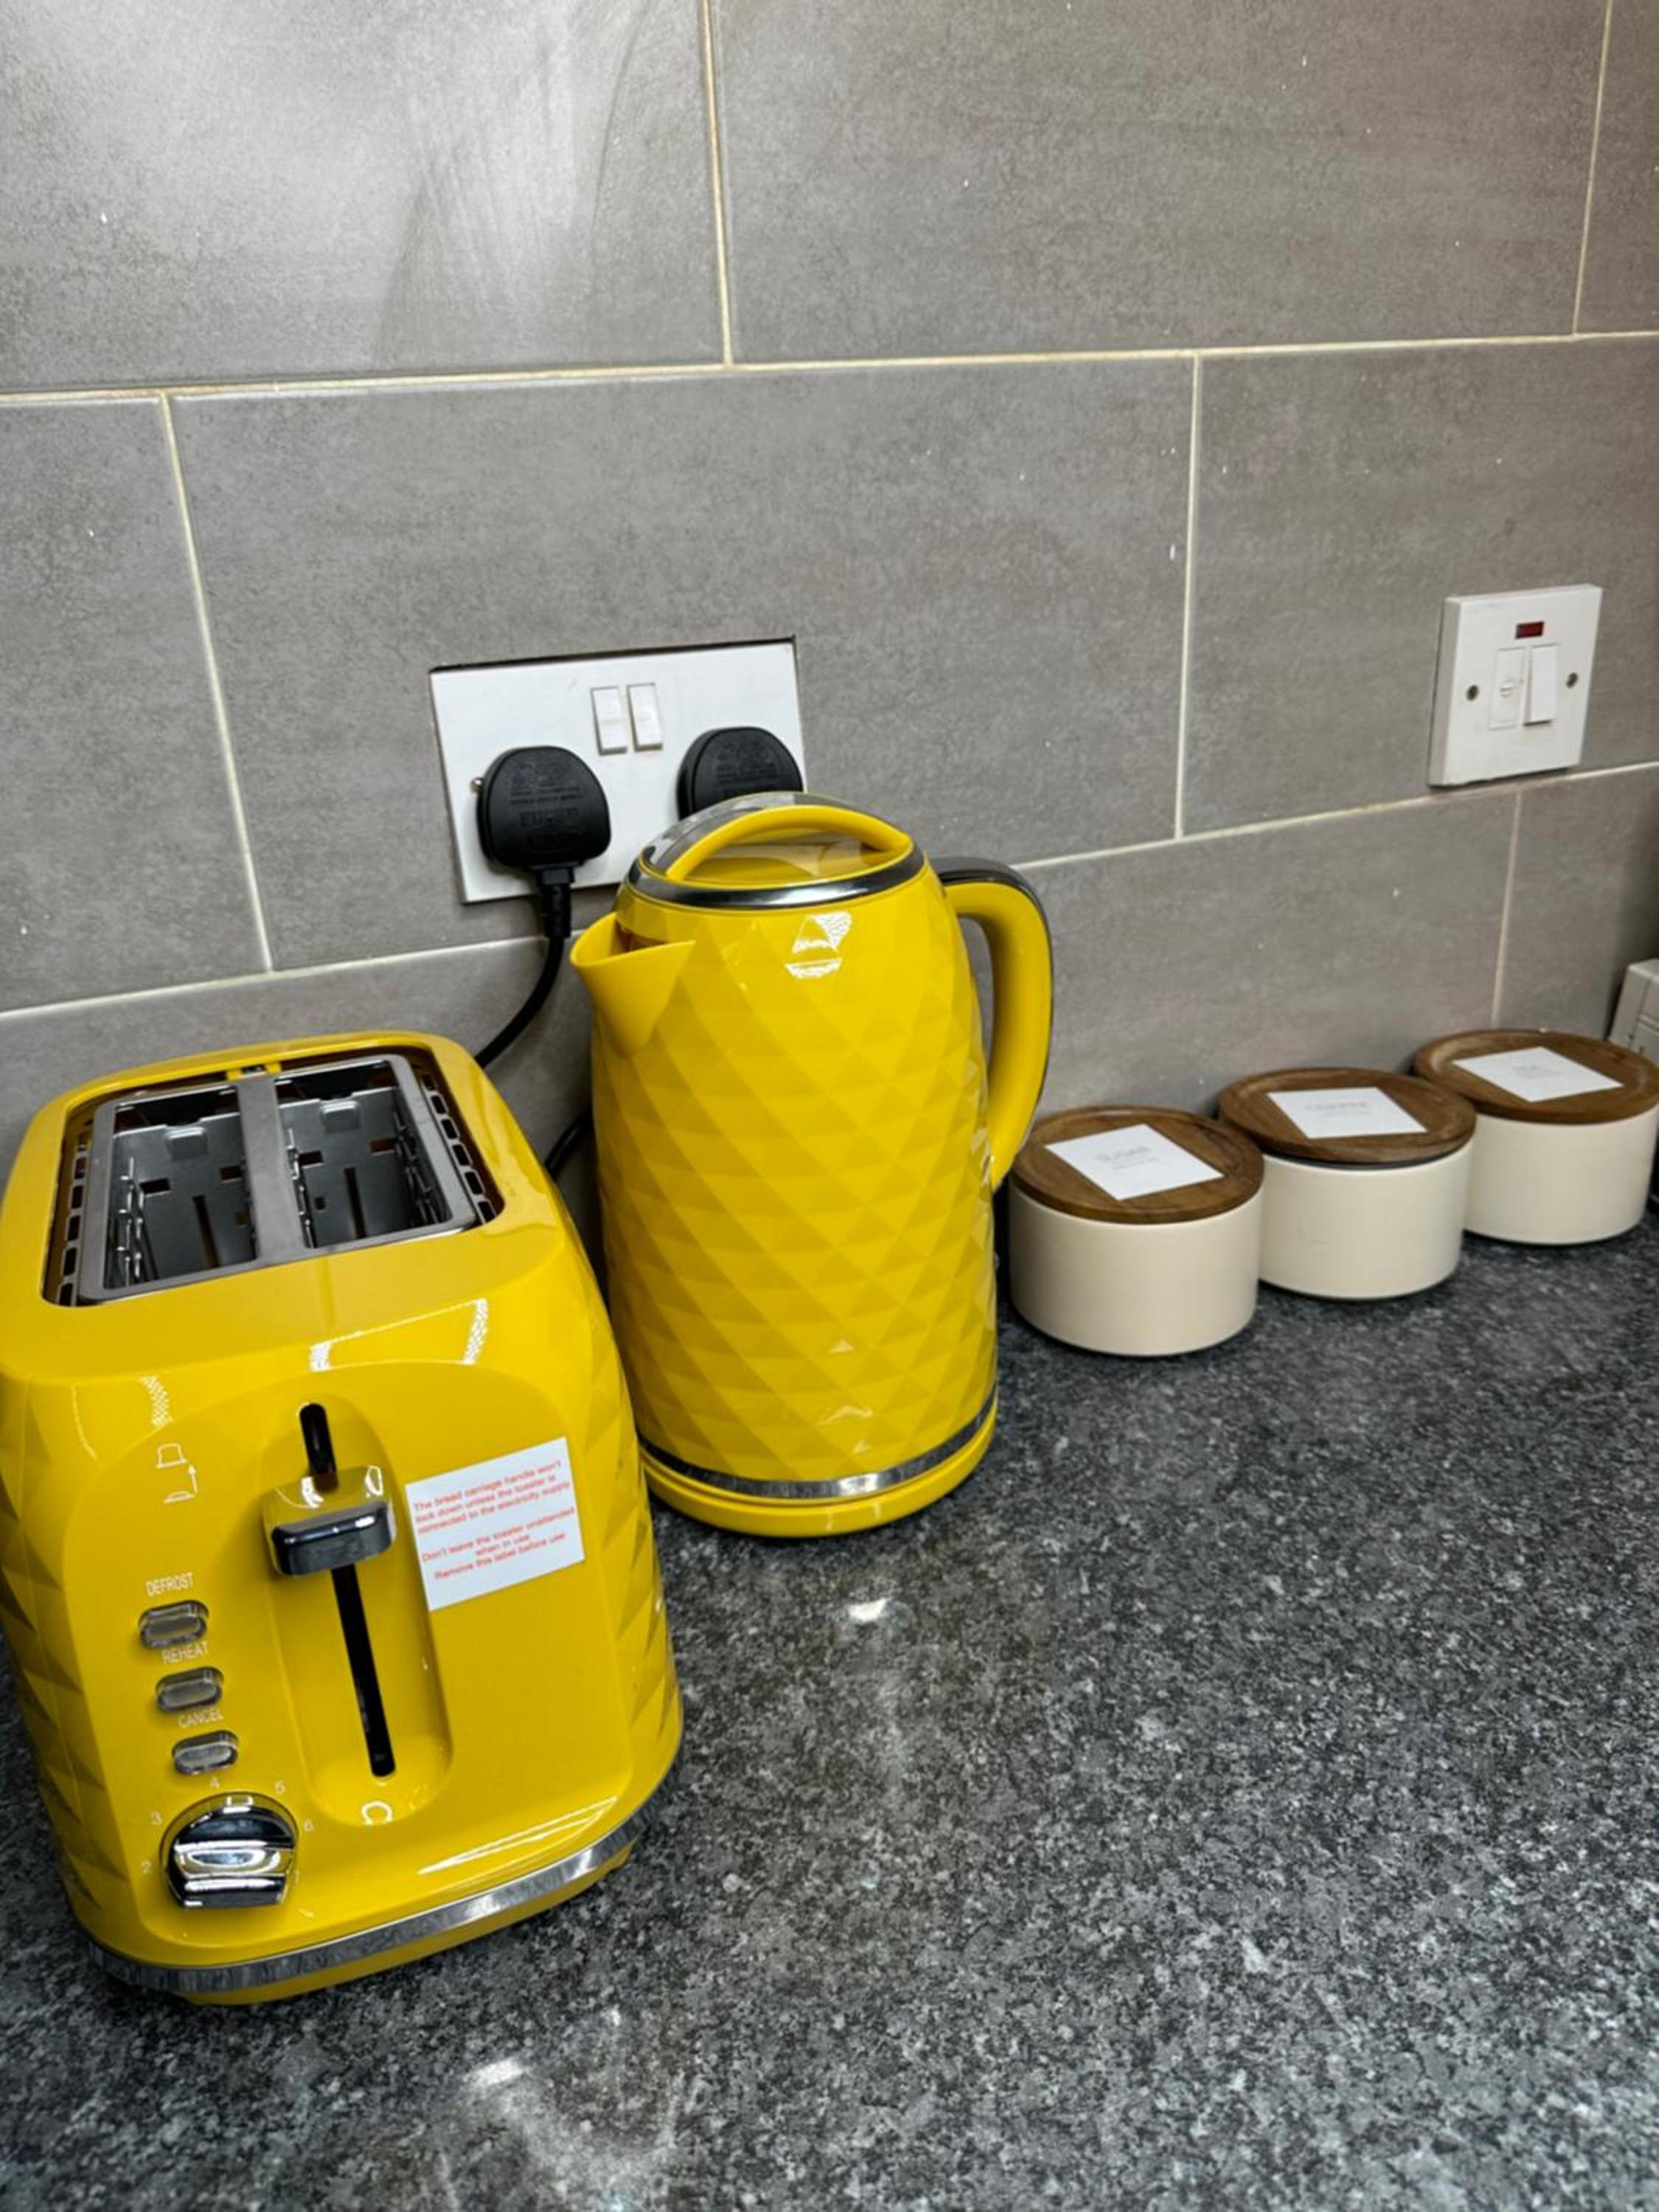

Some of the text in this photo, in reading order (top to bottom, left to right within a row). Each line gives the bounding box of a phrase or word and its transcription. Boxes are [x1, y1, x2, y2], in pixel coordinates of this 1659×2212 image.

[414, 1500, 432, 1512] The
[434, 1491, 462, 1506] bread
[464, 1481, 502, 1498] carriage
[504, 1470, 535, 1485] handle
[437, 1503, 462, 1517] down
[465, 1495, 496, 1508] unless
[498, 1489, 512, 1500] the
[514, 1478, 546, 1493] toaster
[417, 1514, 467, 1535] connected
[480, 1506, 496, 1516] the
[497, 1491, 540, 1512] electricity
[422, 1507, 575, 1562] Don't leave the toaster unattended
[434, 1532, 566, 1580] Remove this label before use
[145, 1571, 194, 1597] DEFROST
[161, 1640, 209, 1665] REHEAT
[177, 1706, 224, 1729] CANCEL
[274, 1781, 286, 1795] 5
[150, 1811, 162, 1826] 3
[303, 1818, 314, 1832] 6
[141, 1859, 153, 1875] 2
